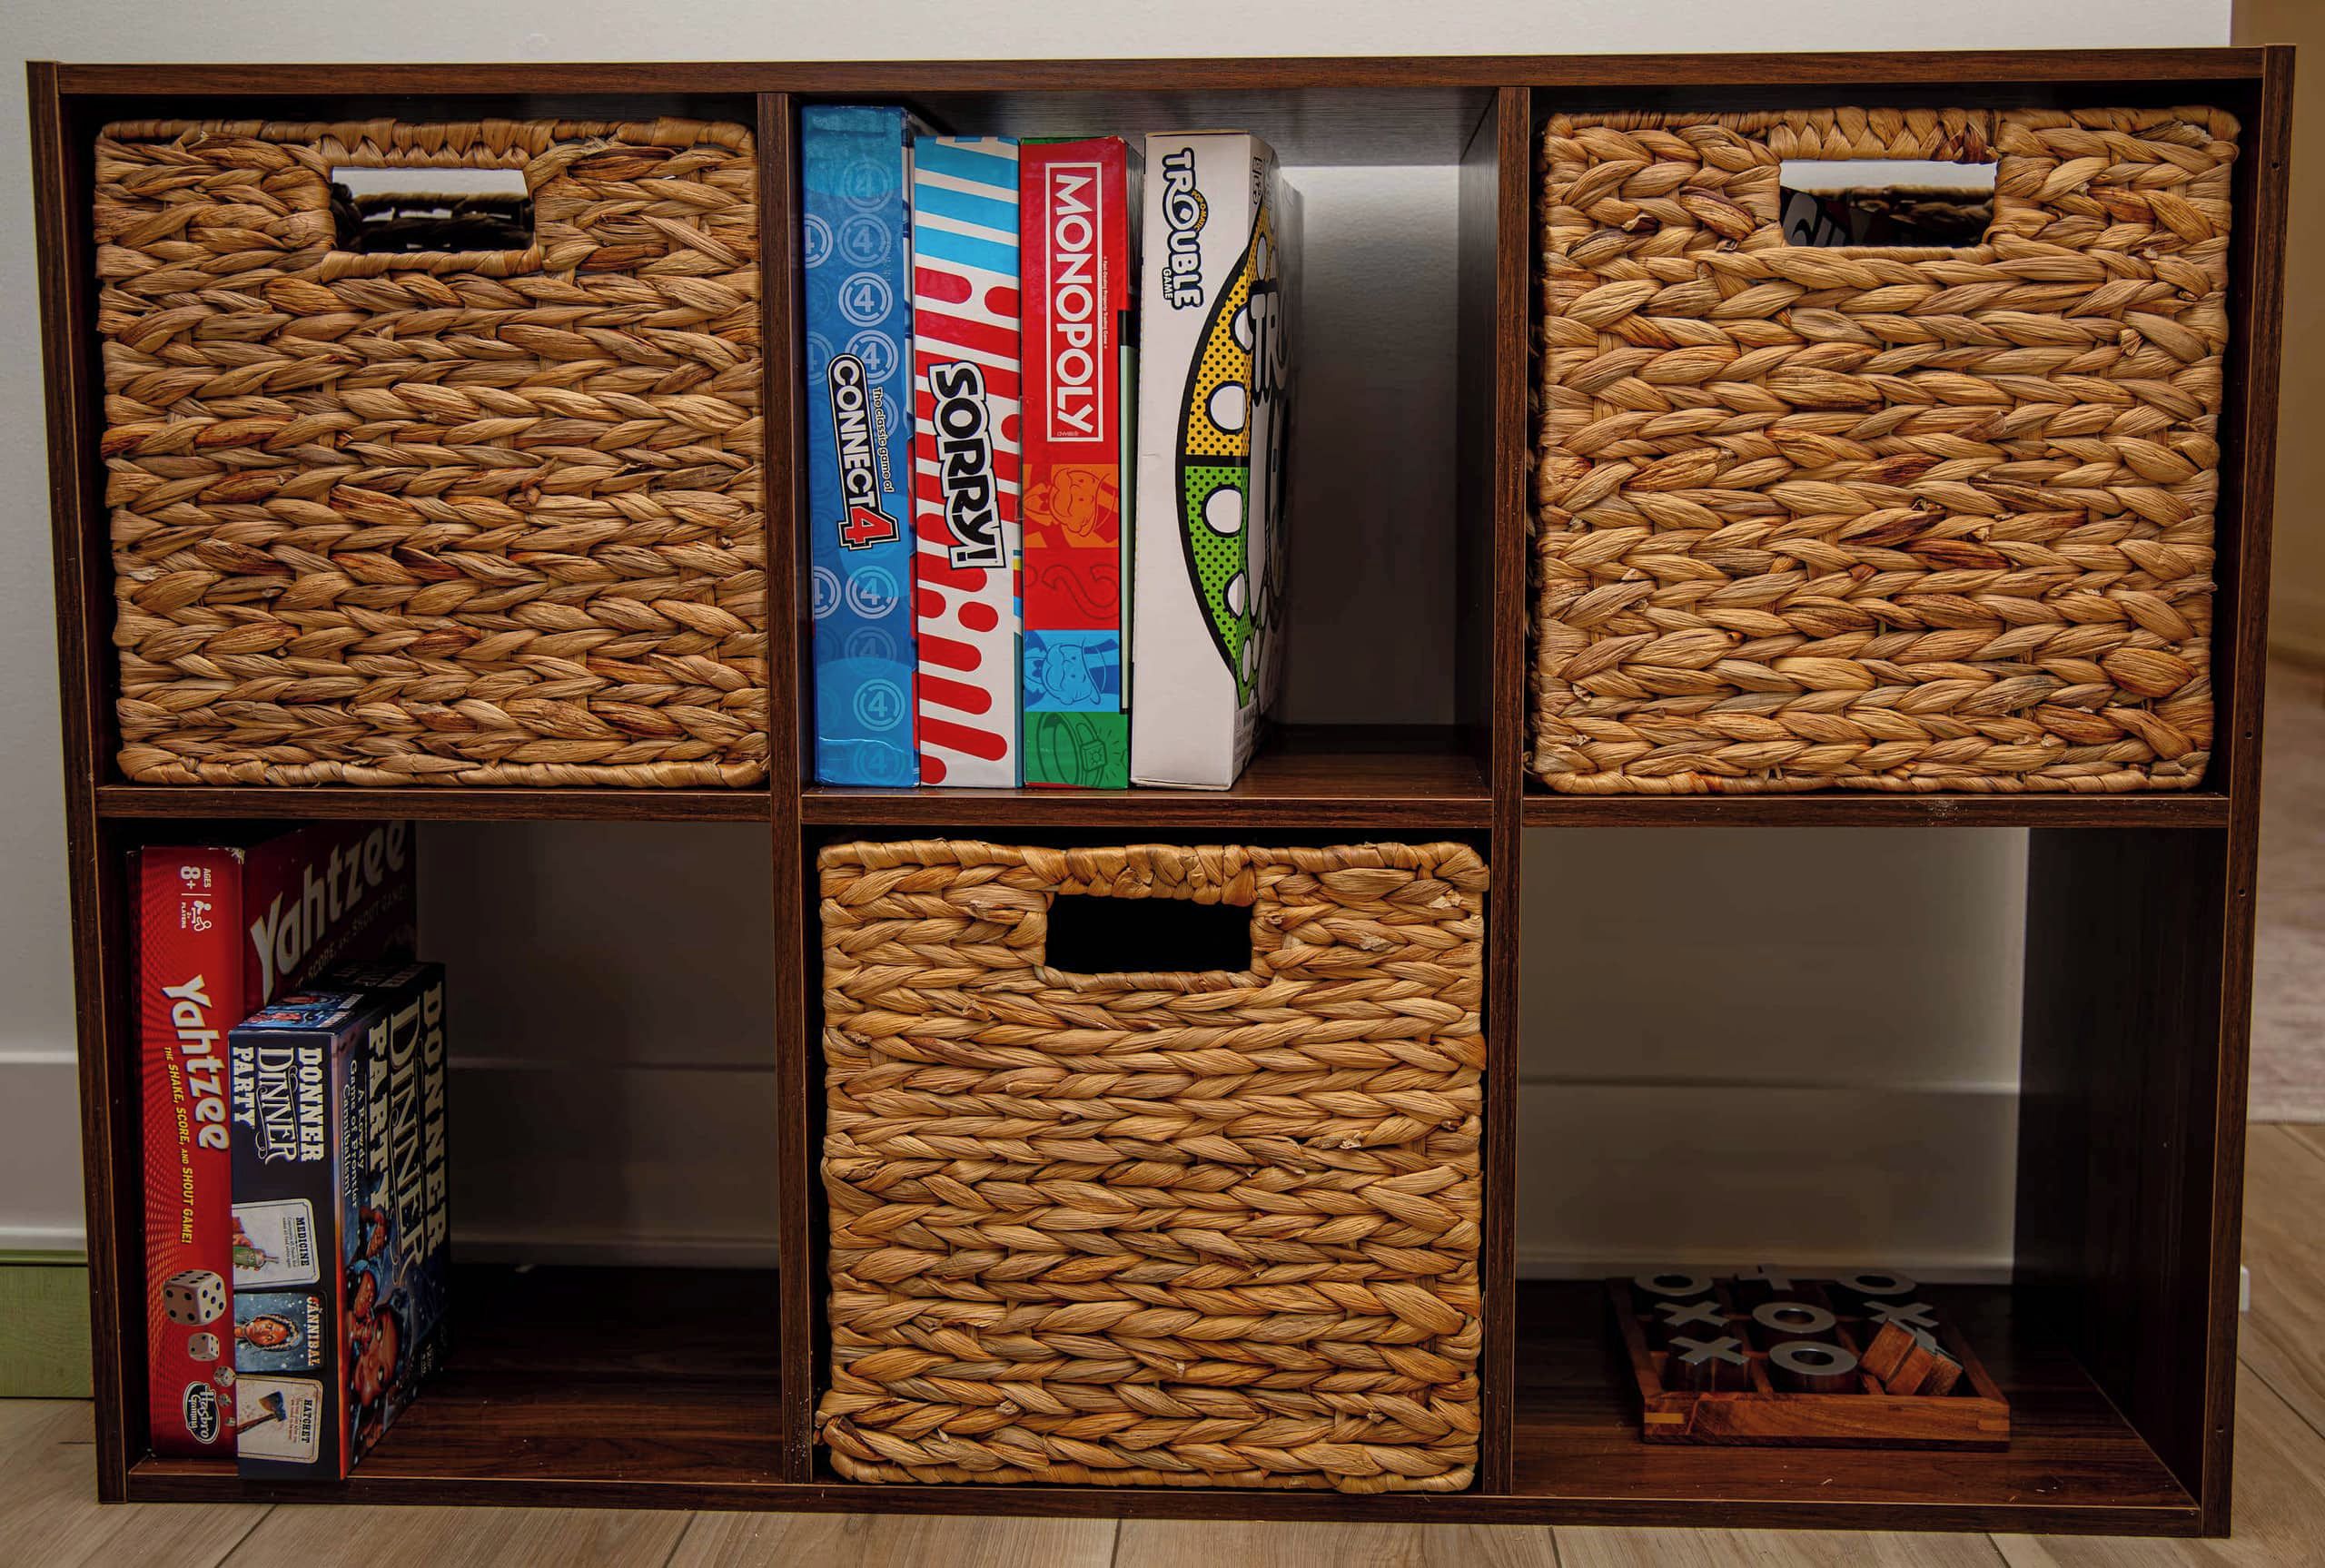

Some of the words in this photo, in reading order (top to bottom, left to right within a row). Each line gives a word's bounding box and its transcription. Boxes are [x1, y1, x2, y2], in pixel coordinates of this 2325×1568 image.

[1162, 148, 1203, 309] TROUBLE
[1055, 174, 1093, 433] MONOPOLY
[1163, 270, 1173, 299] GAME
[873, 388, 882, 408] The
[833, 360, 876, 508] CONNECT
[876, 409, 887, 446] classic
[878, 449, 890, 478] game
[885, 480, 895, 491] of
[933, 364, 1001, 564] SORRY!
[841, 505, 897, 547] 4
[181, 866, 201, 889] 8+
[203, 868, 212, 888] AGES
[250, 820, 407, 1007] Yahtzee
[162, 974, 231, 1150] Yahtzee
[164, 1047, 174, 1061] THE
[168, 1063, 184, 1104] SHAKE,
[232, 1047, 255, 1129] PARTY
[258, 1047, 298, 1166] DINNER
[298, 1047, 325, 1161] DONNER
[351, 1060, 359, 1107] Game
[176, 1109, 191, 1146] SCORE,
[351, 1114, 359, 1132] of
[369, 1017, 390, 1210] PARTY
[423, 981, 447, 1257] DONNER
[181, 1149, 190, 1165] AND
[343, 1083, 351, 1198] Cannibalism!
[391, 995, 425, 1285] DINNER
[183, 1167, 194, 1207] SHOUT
[351, 1139, 359, 1208] Frontier
[182, 1208, 194, 1244] GAME!
[296, 1217, 310, 1266] MEDICINE
[307, 1296, 321, 1366] CANNIBAL
[189, 1395, 201, 1429] Gaming
[198, 1385, 214, 1438] Hasbro
[302, 1399, 312, 1444] HATCHET
